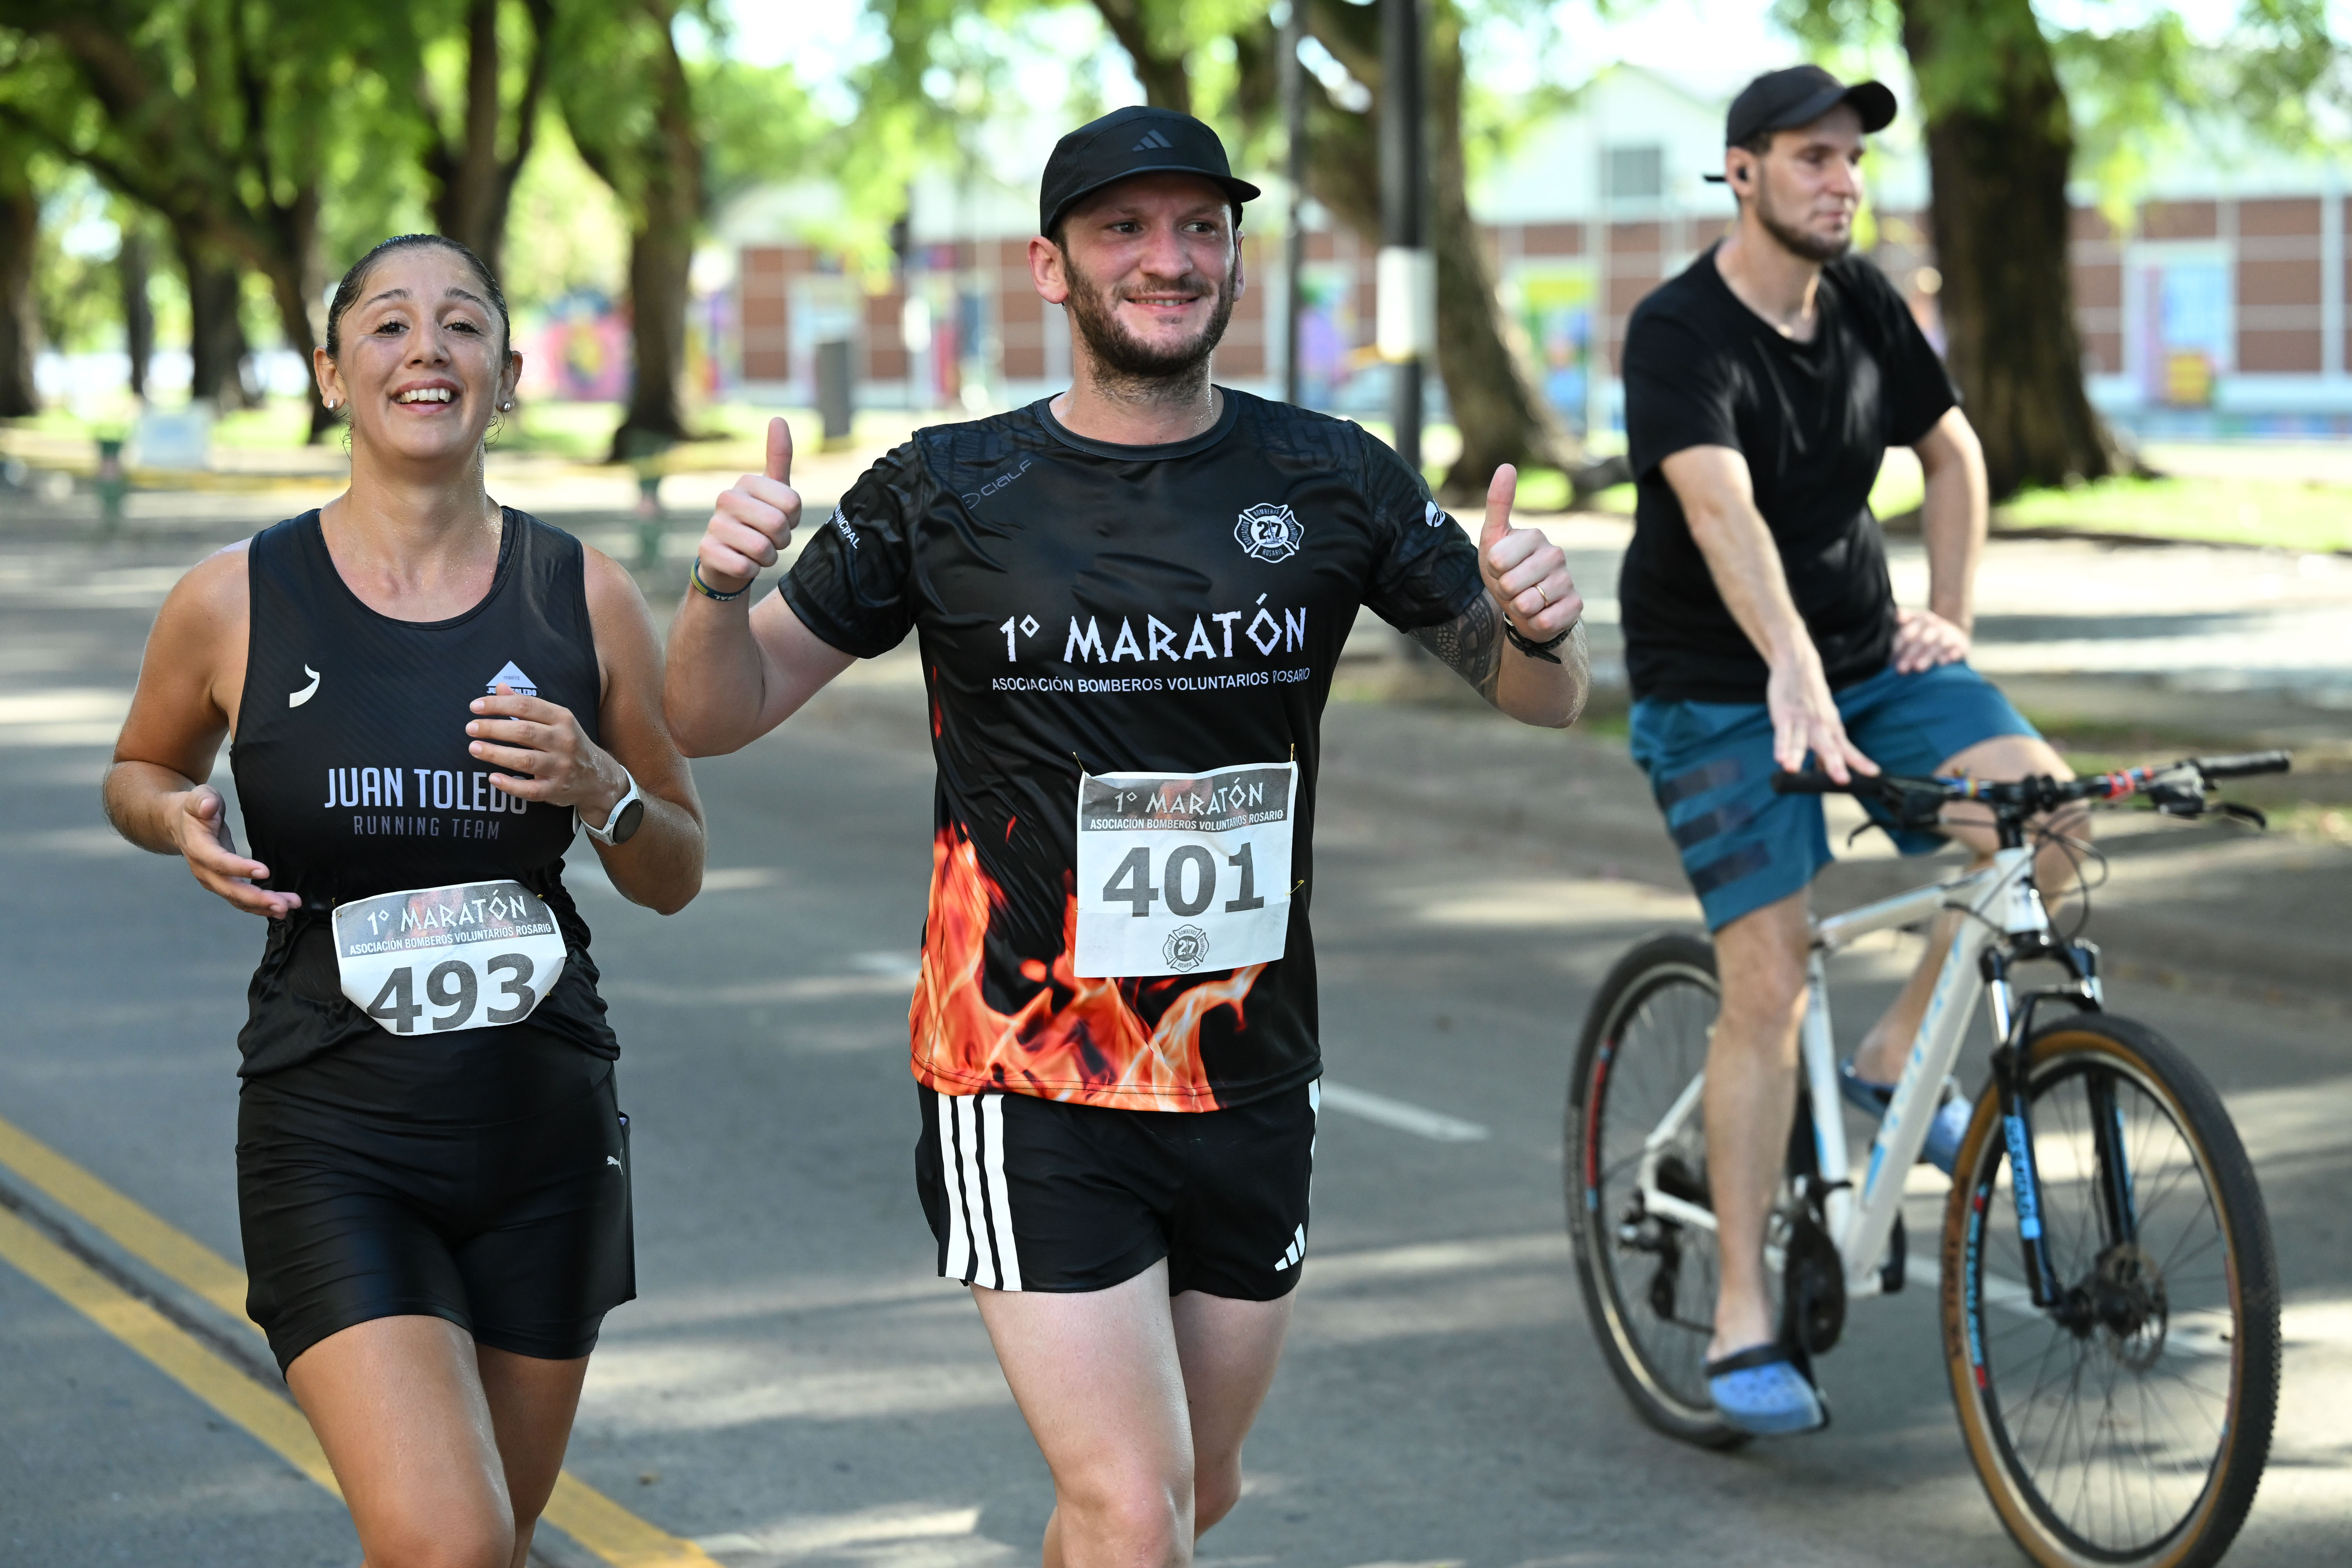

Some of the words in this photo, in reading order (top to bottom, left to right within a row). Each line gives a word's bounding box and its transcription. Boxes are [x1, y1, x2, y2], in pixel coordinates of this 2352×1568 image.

[1252, 508, 1280, 517] BOMBEROS
[1241, 521, 1253, 546] ASOCIACIÓN
[1256, 521, 1282, 540] 27
[1262, 548, 1284, 556] ROSARIO
[1063, 592, 1307, 664] MARATÓN
[992, 676, 1074, 693] ASOCIACIÓN
[1079, 679, 1163, 693] BOMBEROS
[1167, 671, 1269, 690] VOLUNTARIOS
[1273, 667, 1310, 684] ROSARIO
[325, 767, 403, 808] JUAN
[414, 768, 527, 814] TOLEDO
[1145, 777, 1264, 816] MARATÓN
[354, 816, 439, 836] RUNNING
[452, 819, 500, 840] TEAM
[1090, 816, 1144, 830] ASOCIACIÓN
[1147, 818, 1197, 830] BOMBEROS
[1199, 815, 1247, 831] VOLUNTARIOS
[1249, 809, 1283, 823] ROSARIO
[1102, 842, 1264, 917] 401
[400, 889, 527, 932] MARATÓN
[350, 937, 403, 956] ASOCIACIÓN
[405, 933, 453, 950] BOMBEROS
[455, 926, 514, 943] VOLUNTARIOS
[515, 922, 551, 935] ROSARIO
[1178, 939, 1196, 956] 27
[367, 953, 536, 1033] 493
